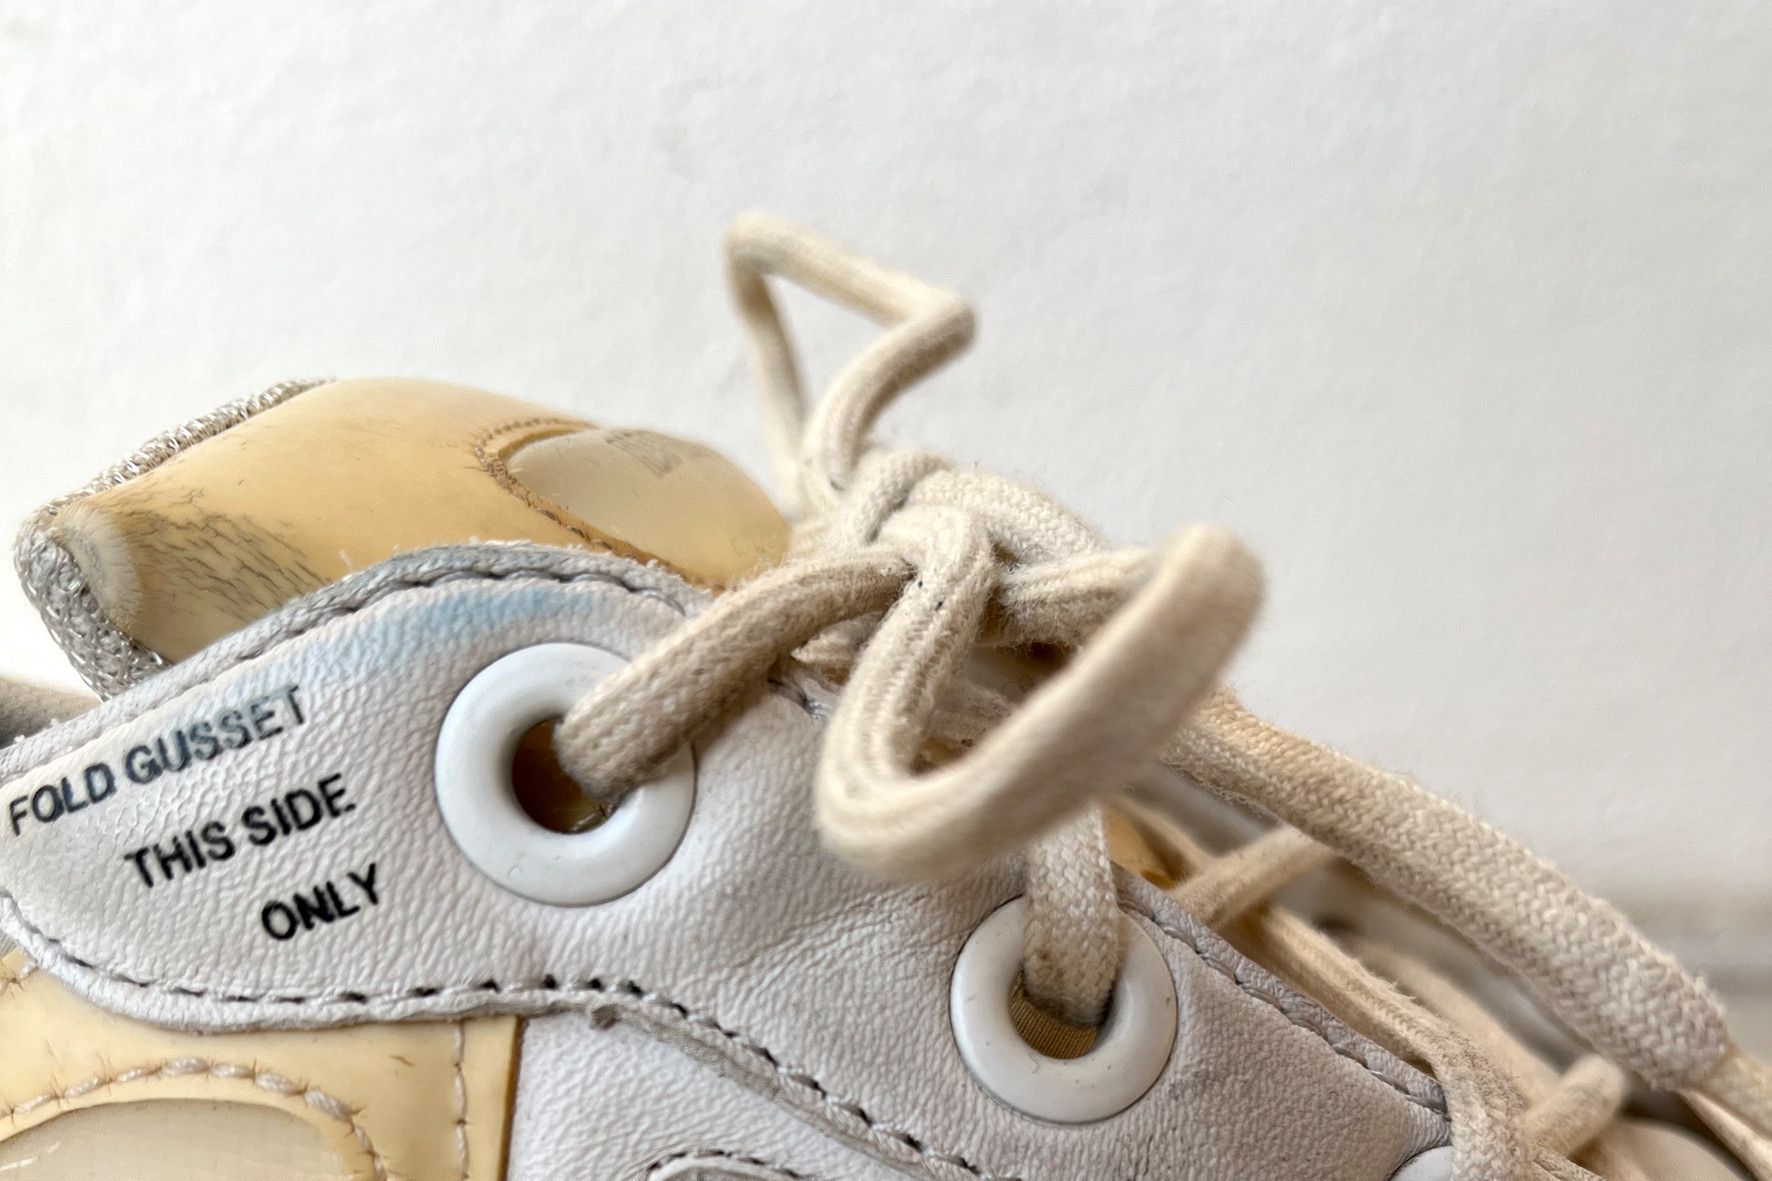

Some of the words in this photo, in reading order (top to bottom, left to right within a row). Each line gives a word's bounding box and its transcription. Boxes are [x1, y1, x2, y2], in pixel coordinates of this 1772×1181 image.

[9, 763, 116, 836] FOLD
[123, 685, 305, 785] GUSSET
[125, 822, 235, 888] THIS
[242, 773, 356, 847] SIDE
[261, 863, 379, 941] ONLY
